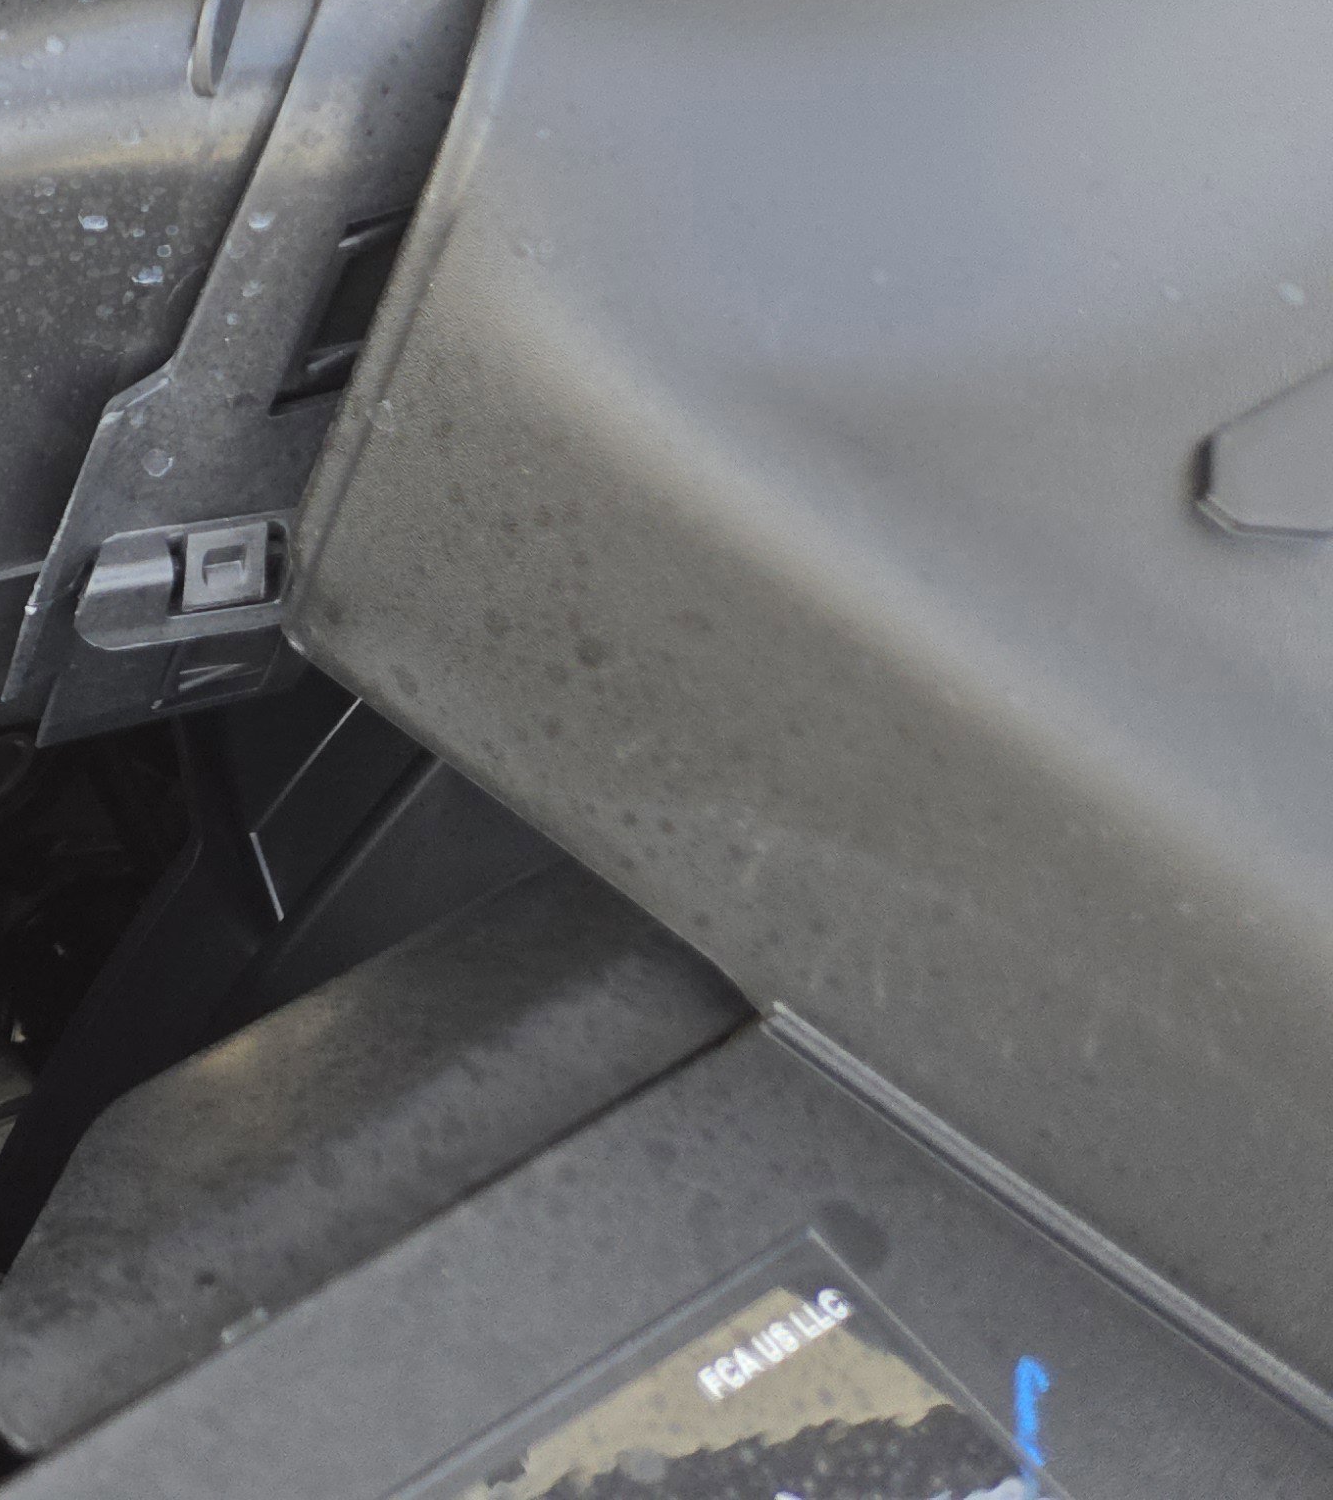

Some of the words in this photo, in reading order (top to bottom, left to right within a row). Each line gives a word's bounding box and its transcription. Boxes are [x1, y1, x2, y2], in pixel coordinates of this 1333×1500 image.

[698, 1347, 763, 1401] FCA
[751, 1322, 799, 1362] US
[788, 1288, 850, 1339] LLC
